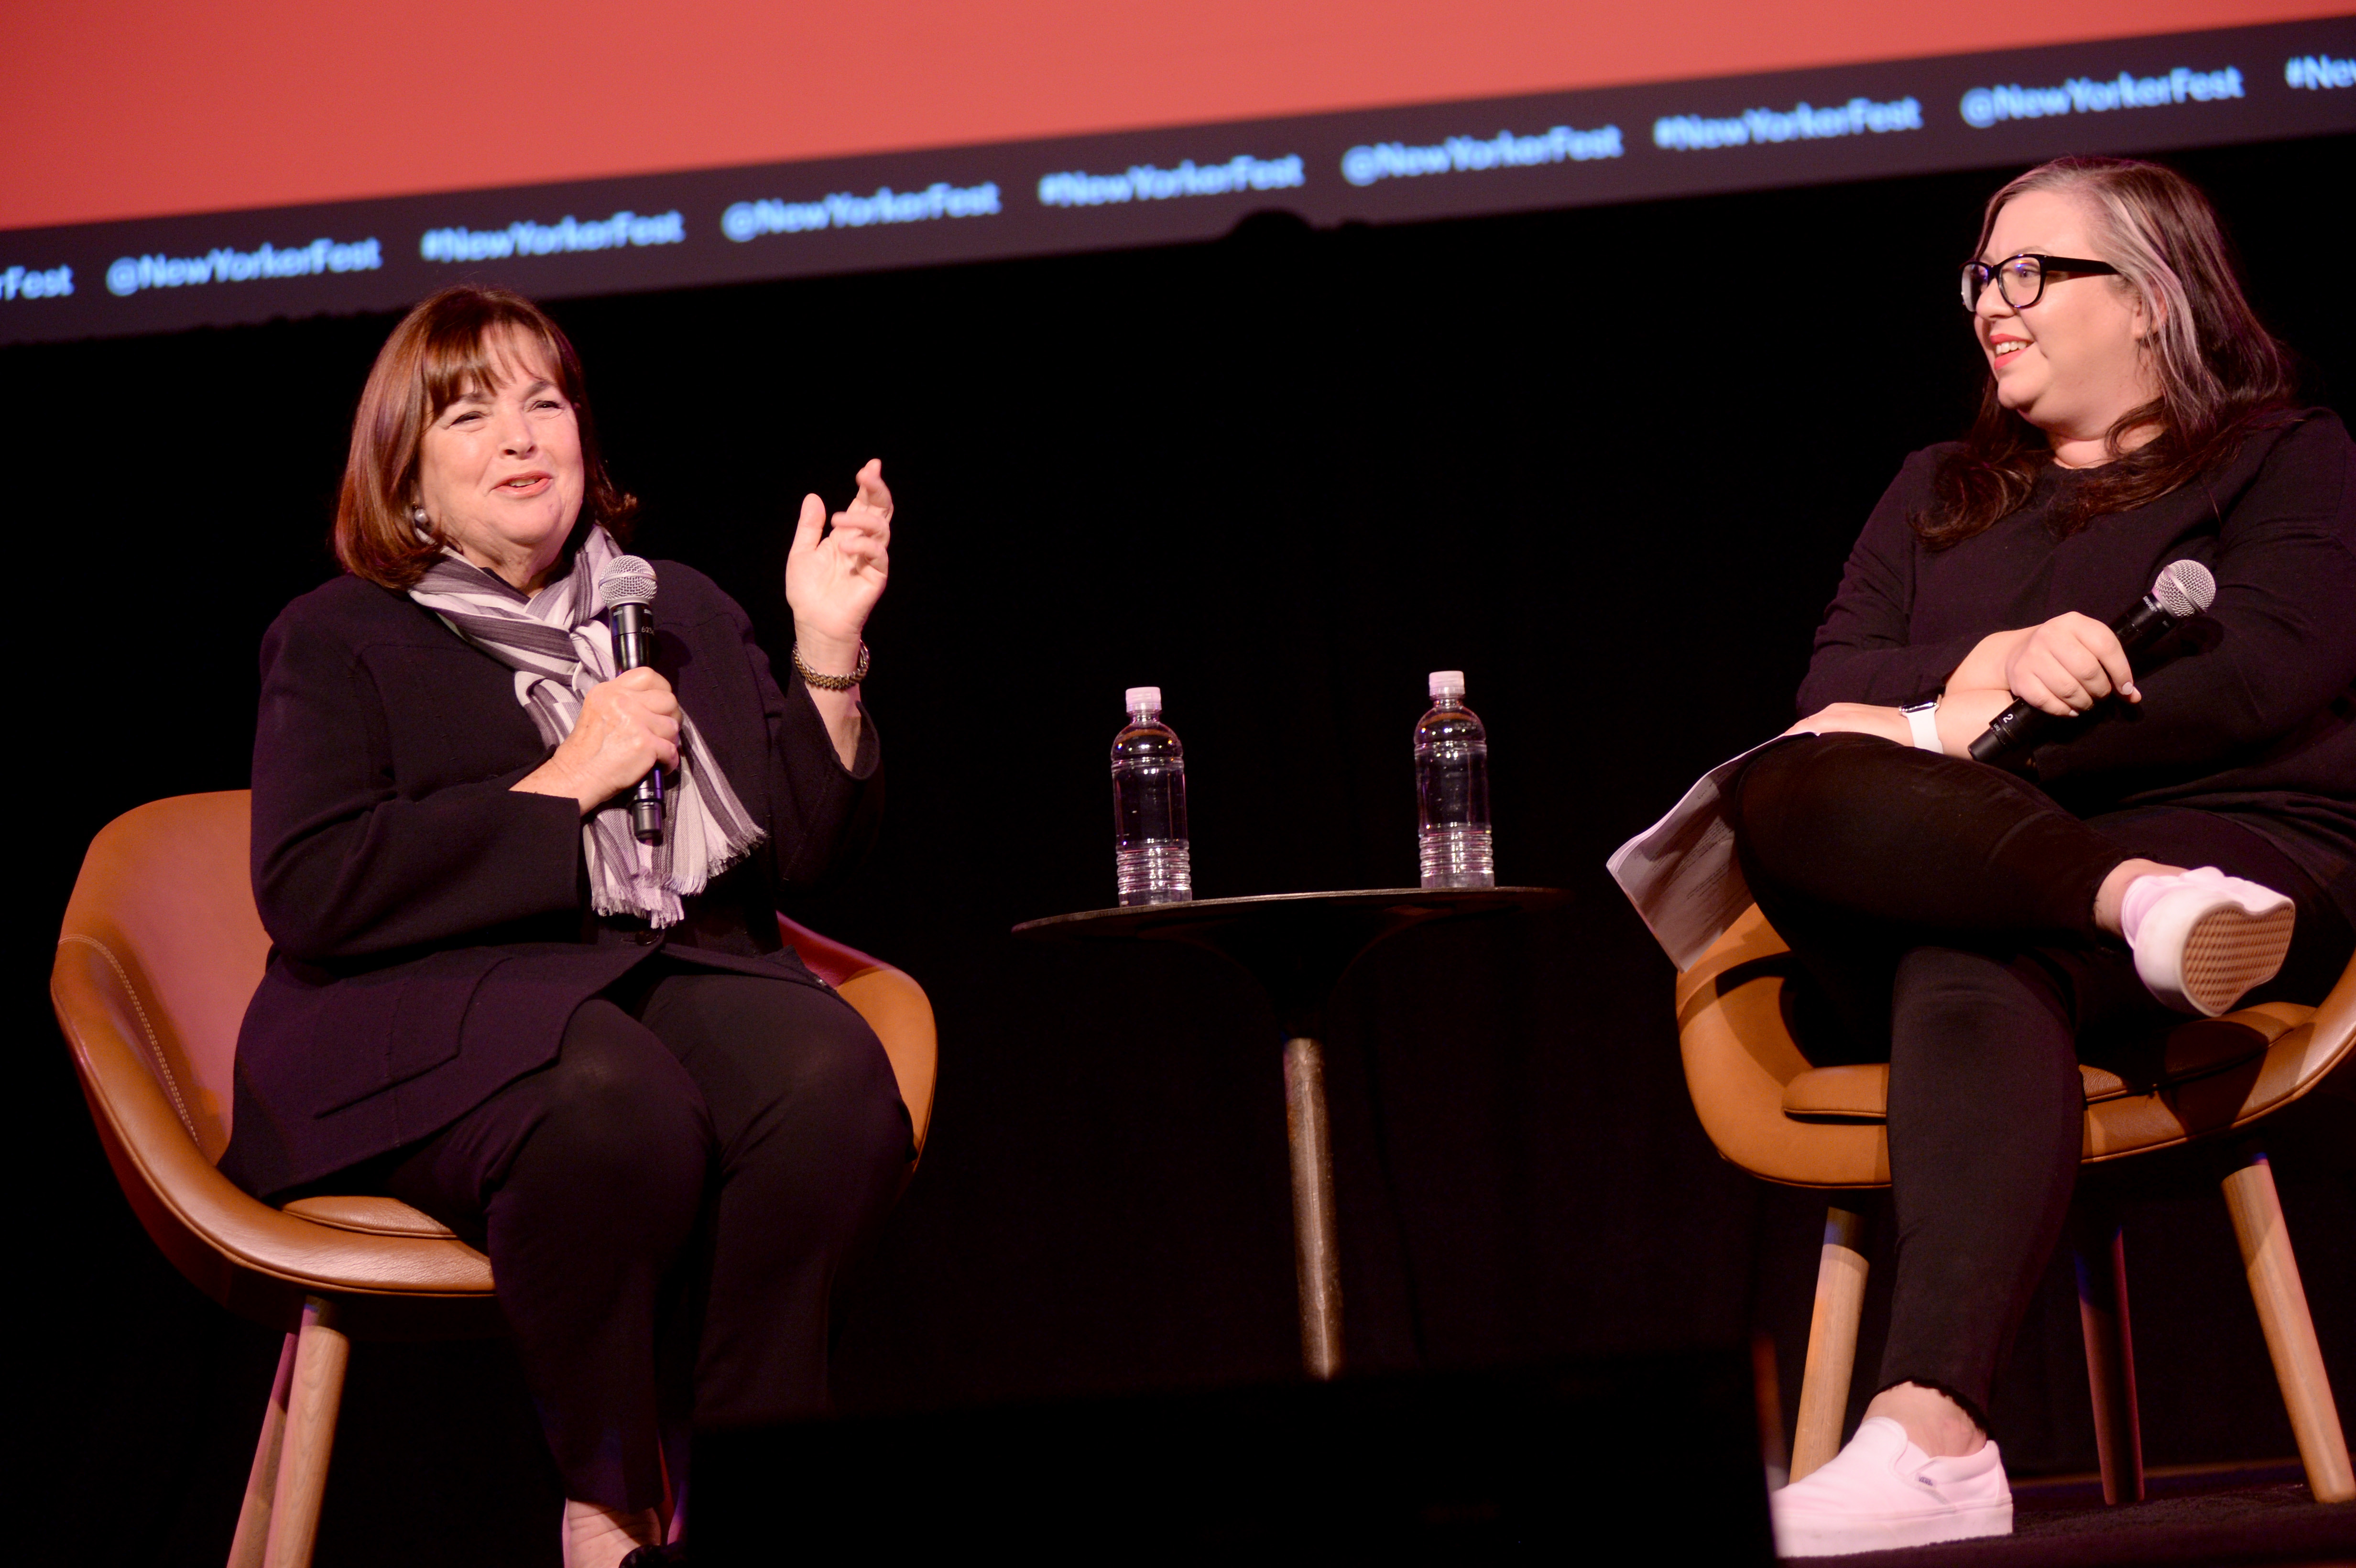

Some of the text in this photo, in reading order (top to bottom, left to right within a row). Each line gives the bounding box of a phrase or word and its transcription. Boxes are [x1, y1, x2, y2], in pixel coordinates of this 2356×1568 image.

[107, 237, 383, 295] @NewYorkerFest
[421, 210, 686, 262] #NewYorkerFest
[722, 181, 1002, 242] @NewYorkerFest
[1038, 153, 1305, 207] #NewYorkerFest
[1342, 124, 1625, 186] @NewYorkerFest
[1653, 96, 1924, 151] #NewYorkerFest
[1960, 65, 2246, 128] @NewYorkerFest
[2285, 54, 2356, 89] #Ne
[2003, 713, 2013, 723] 2
